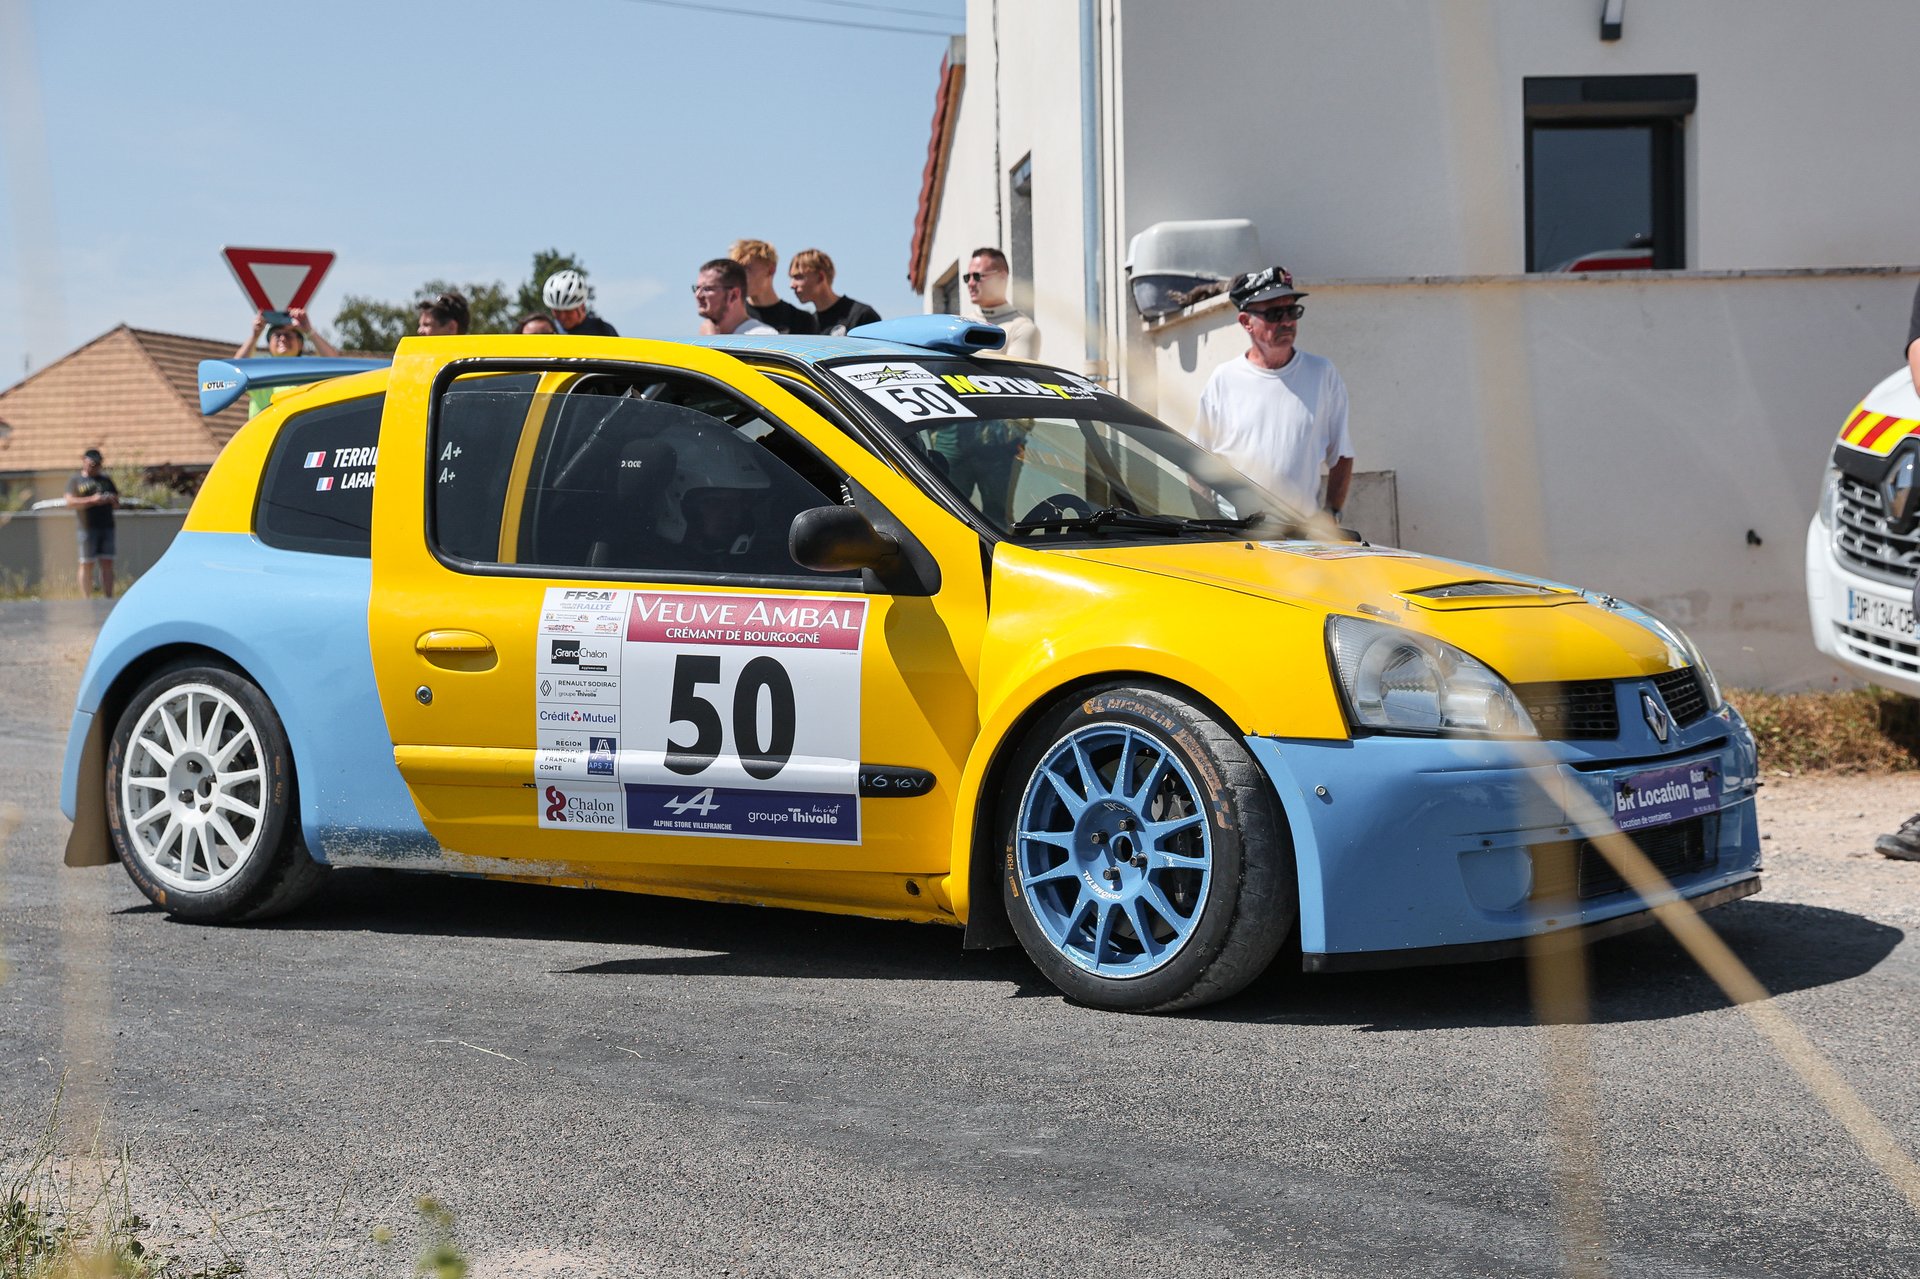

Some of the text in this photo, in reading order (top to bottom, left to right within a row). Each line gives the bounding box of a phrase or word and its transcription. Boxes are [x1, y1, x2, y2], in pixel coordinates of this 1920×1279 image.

[886, 387, 957, 416] 50
[440, 441, 462, 461] A+
[438, 467, 456, 484] A+
[564, 591, 610, 601] FFSA
[635, 596, 859, 630] VEUVE AMBAL
[665, 626, 724, 640] CRÉMANT
[540, 710, 616, 723] Crédit Mutuel
[664, 654, 796, 780] 50
[1106, 698, 1177, 731] MICHELIN
[604, 762, 613, 770] 71
[894, 777, 926, 788] 16V
[568, 797, 614, 811] Chalon
[1616, 790, 1636, 812] BR
[1638, 781, 1690, 808] Location
[576, 810, 615, 824] Saône
[653, 819, 732, 831] ALPINE STORE VILLEFRANCHE
[748, 808, 838, 825] groupe Thivolle
[1620, 818, 1641, 829] Location
[1642, 815, 1649, 825] de
[1006, 853, 1015, 870] H30
[1082, 869, 1123, 900] FONDMETAL
